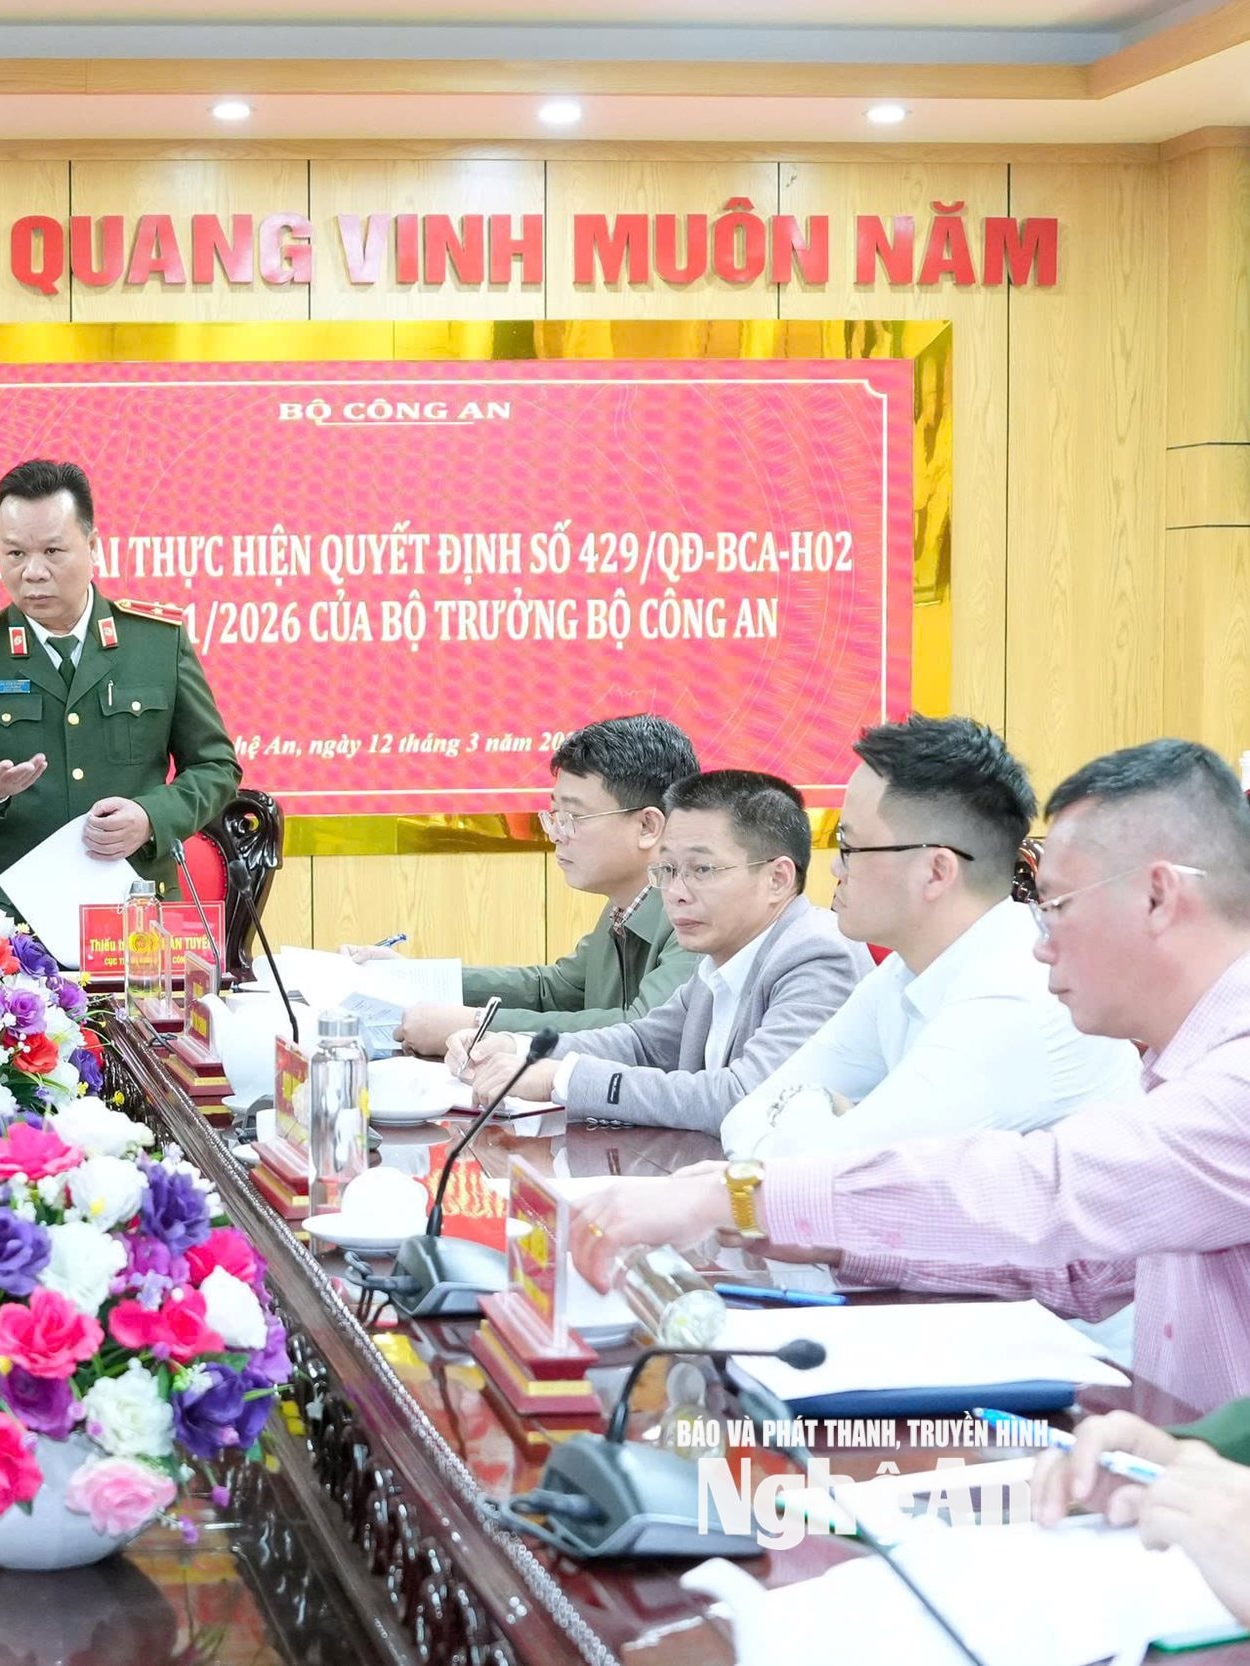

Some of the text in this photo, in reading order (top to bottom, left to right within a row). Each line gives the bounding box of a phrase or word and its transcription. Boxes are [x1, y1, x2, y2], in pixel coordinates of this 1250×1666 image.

[10, 214, 313, 297] QUANG
[338, 213, 544, 285] VINH
[572, 197, 830, 285] MUÔN
[855, 201, 1059, 286] NĂM
[278, 398, 512, 426] BỘ CÔNG AN
[92, 536, 120, 578] AI
[128, 534, 224, 589] THỰC
[232, 523, 312, 587] HIỆN
[319, 520, 431, 585] QUYẾT
[438, 531, 521, 585] ĐỊNH
[530, 519, 572, 574] SỐ
[578, 530, 853, 585] 429/QĐ-BCA-H02
[181, 587, 778, 656] 1/2026 CỦA BỘ TRƯỞNG BỘ CÔNG AN
[234, 731, 572, 760] hệ An, ngày 12 tháng 3 năm 20
